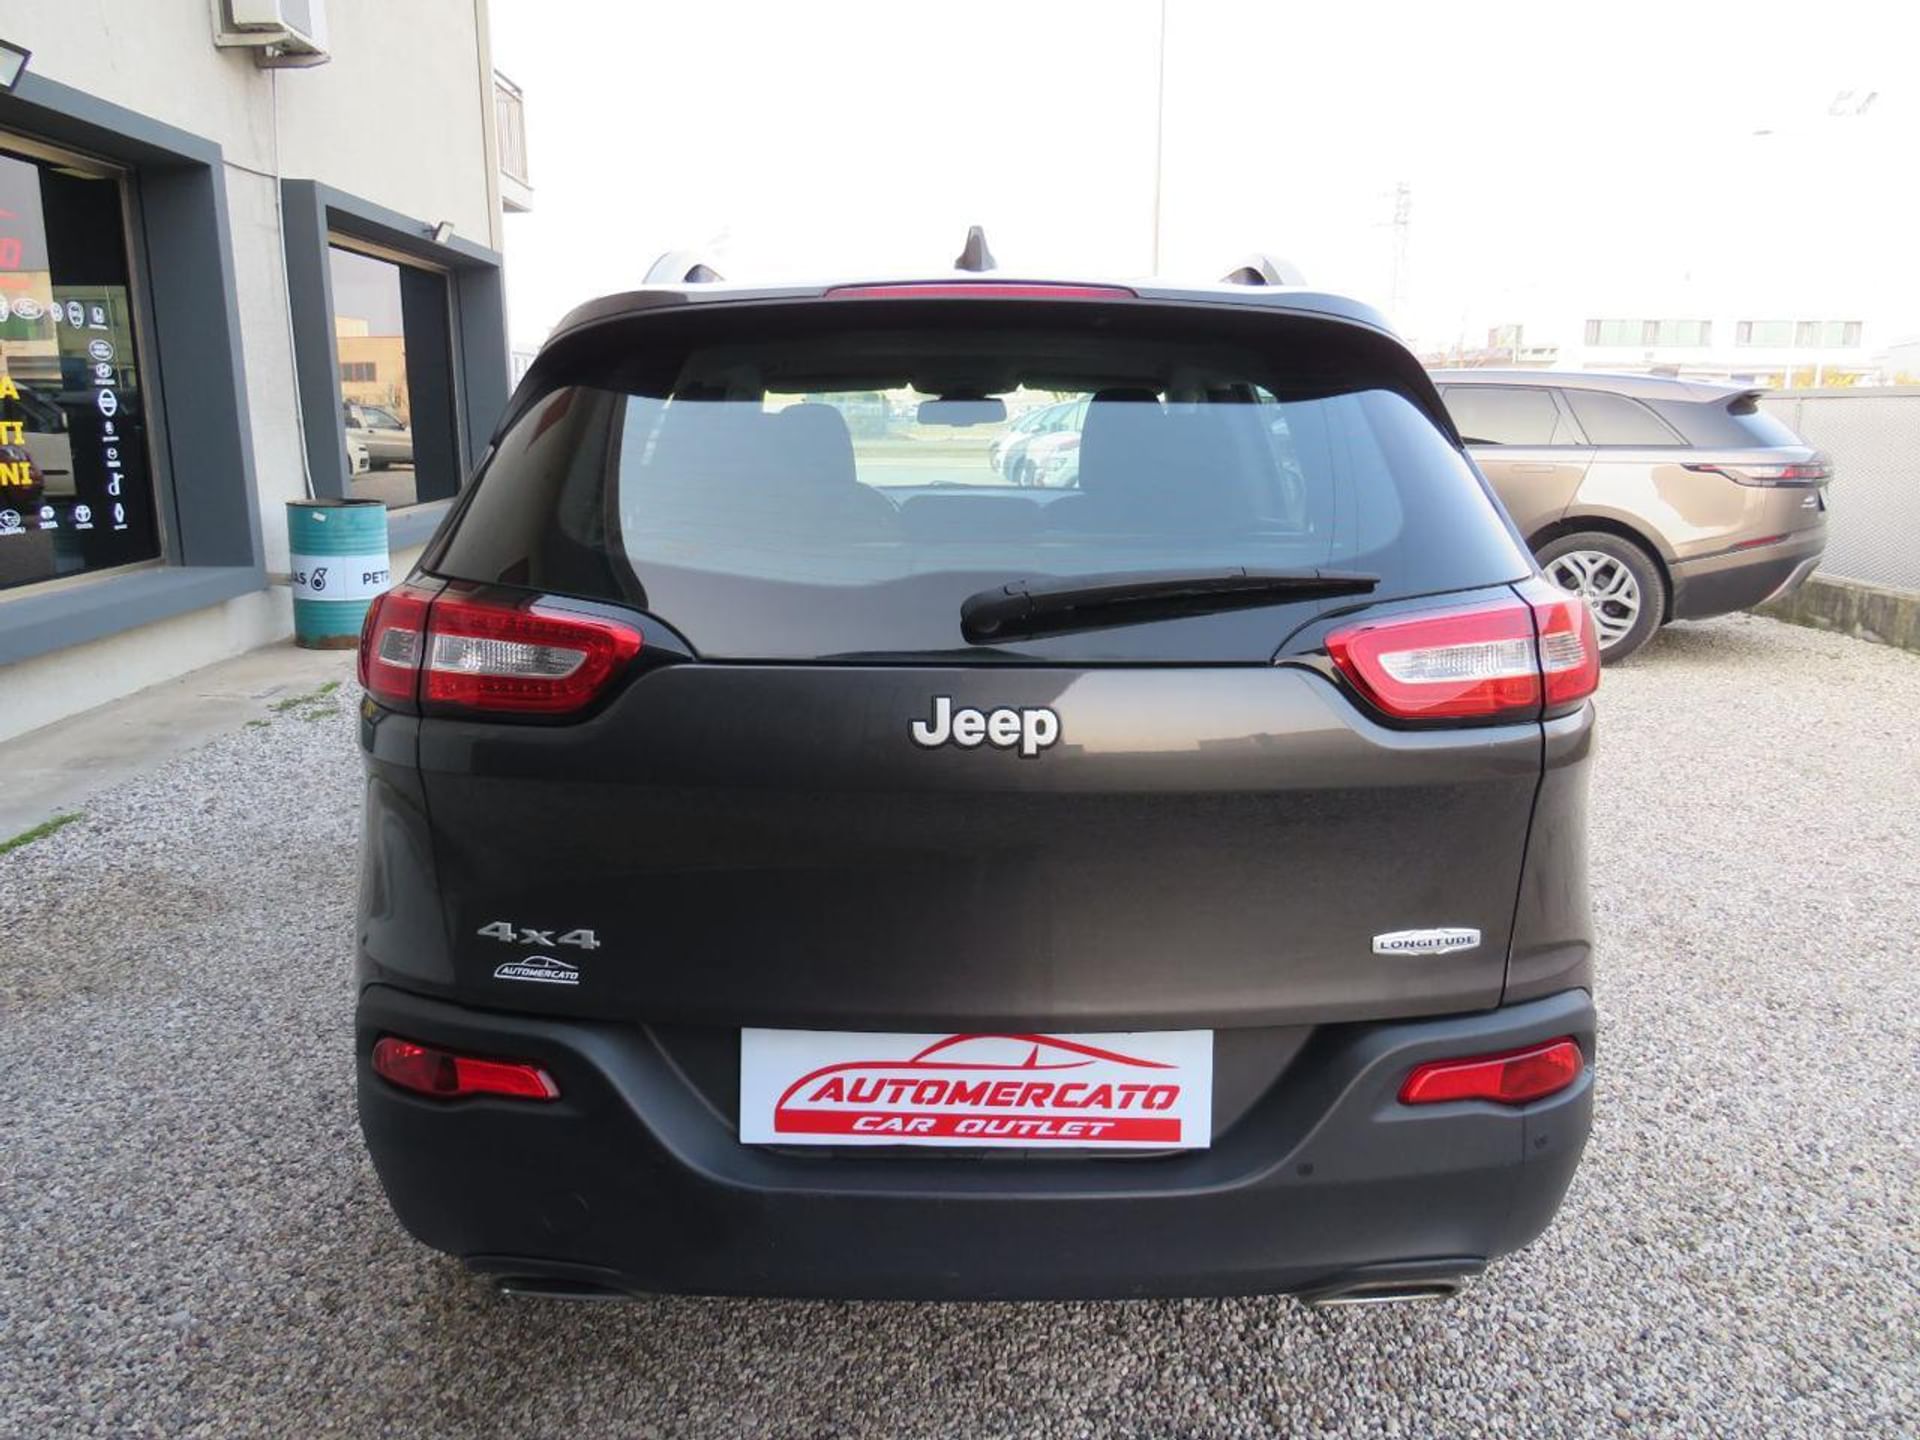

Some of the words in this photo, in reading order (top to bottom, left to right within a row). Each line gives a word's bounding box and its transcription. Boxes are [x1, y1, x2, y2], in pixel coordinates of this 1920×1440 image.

[910, 696, 1060, 757] Jeep
[1380, 935, 1476, 950] LONGITUDE
[501, 966, 579, 980] AUTOMERCATO
[808, 1077, 1181, 1111] AUTOMERCATO
[852, 1116, 936, 1134] CAR
[955, 1118, 1115, 1137] OUTLET
